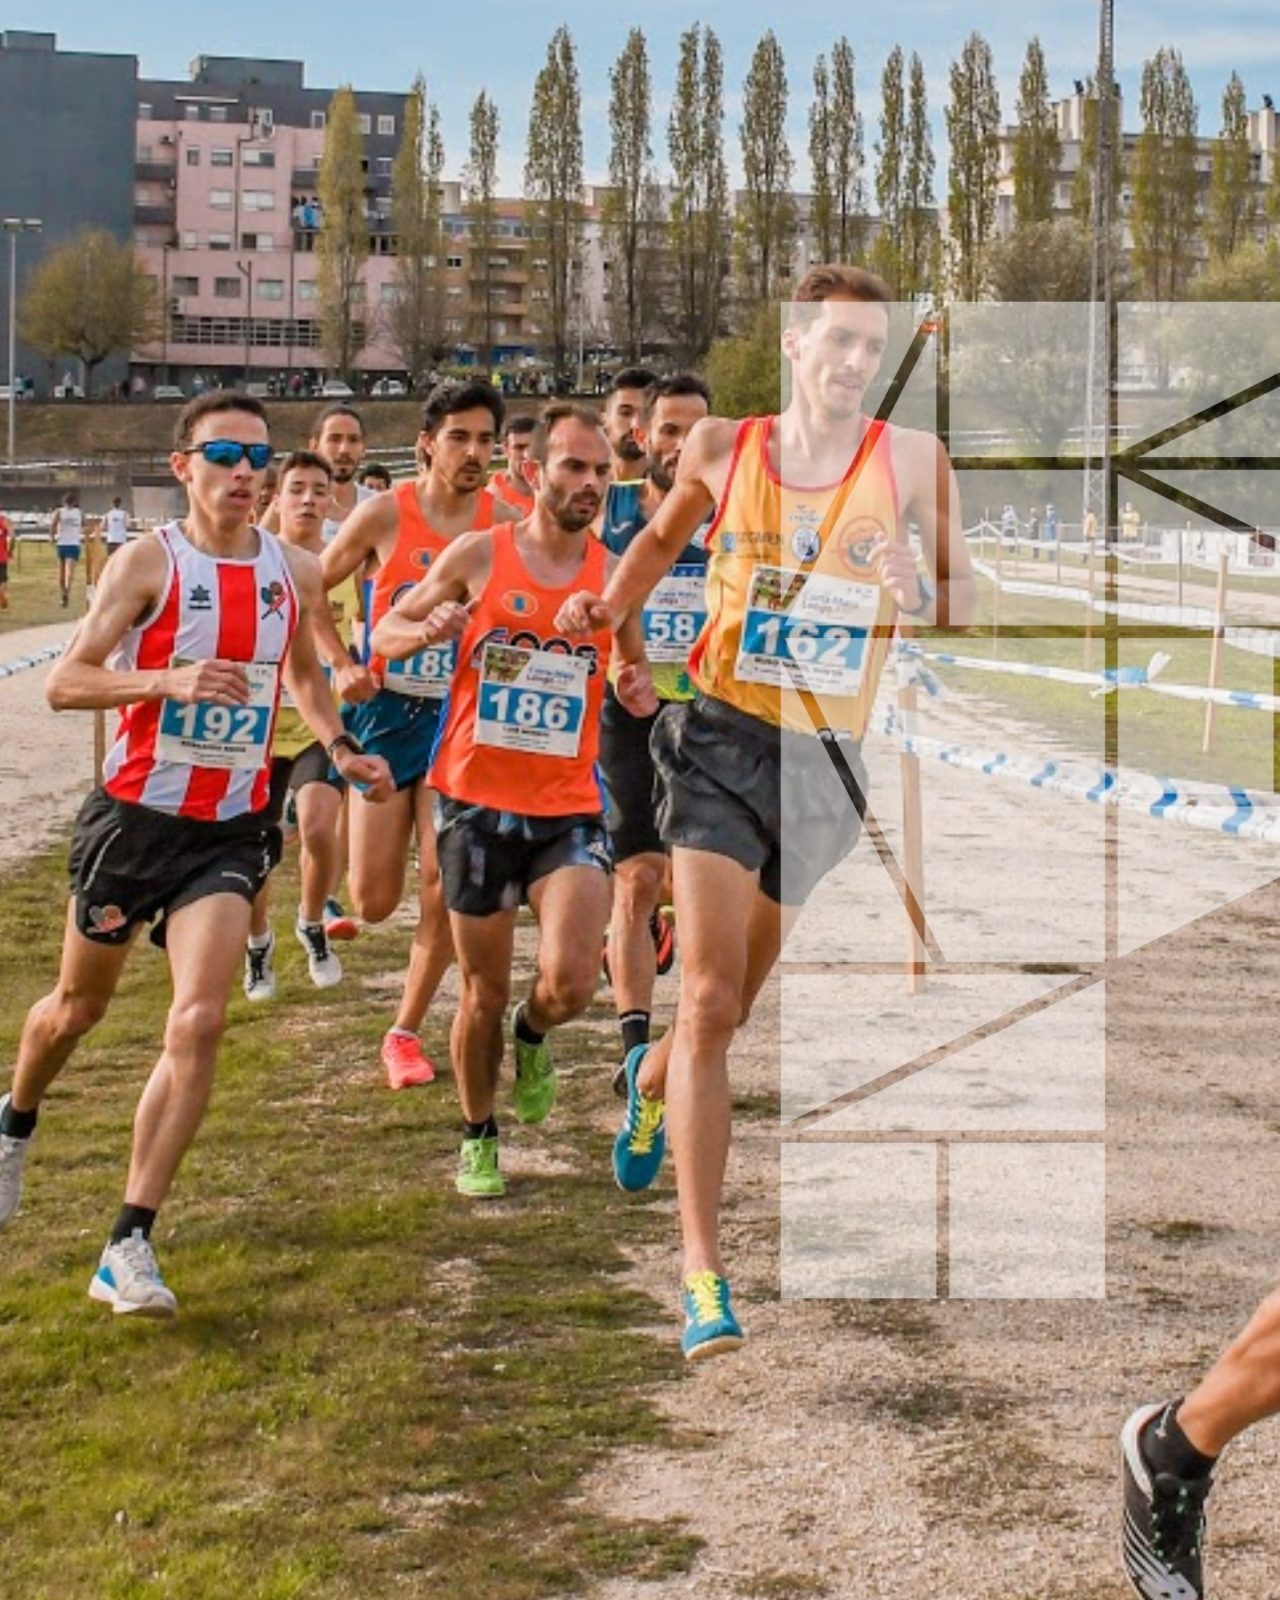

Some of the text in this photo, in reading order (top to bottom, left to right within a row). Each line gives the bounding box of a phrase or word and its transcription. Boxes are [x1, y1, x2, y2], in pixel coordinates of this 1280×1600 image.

[756, 617, 852, 667] 162
[175, 703, 259, 743] 192
[489, 688, 571, 730] 186
